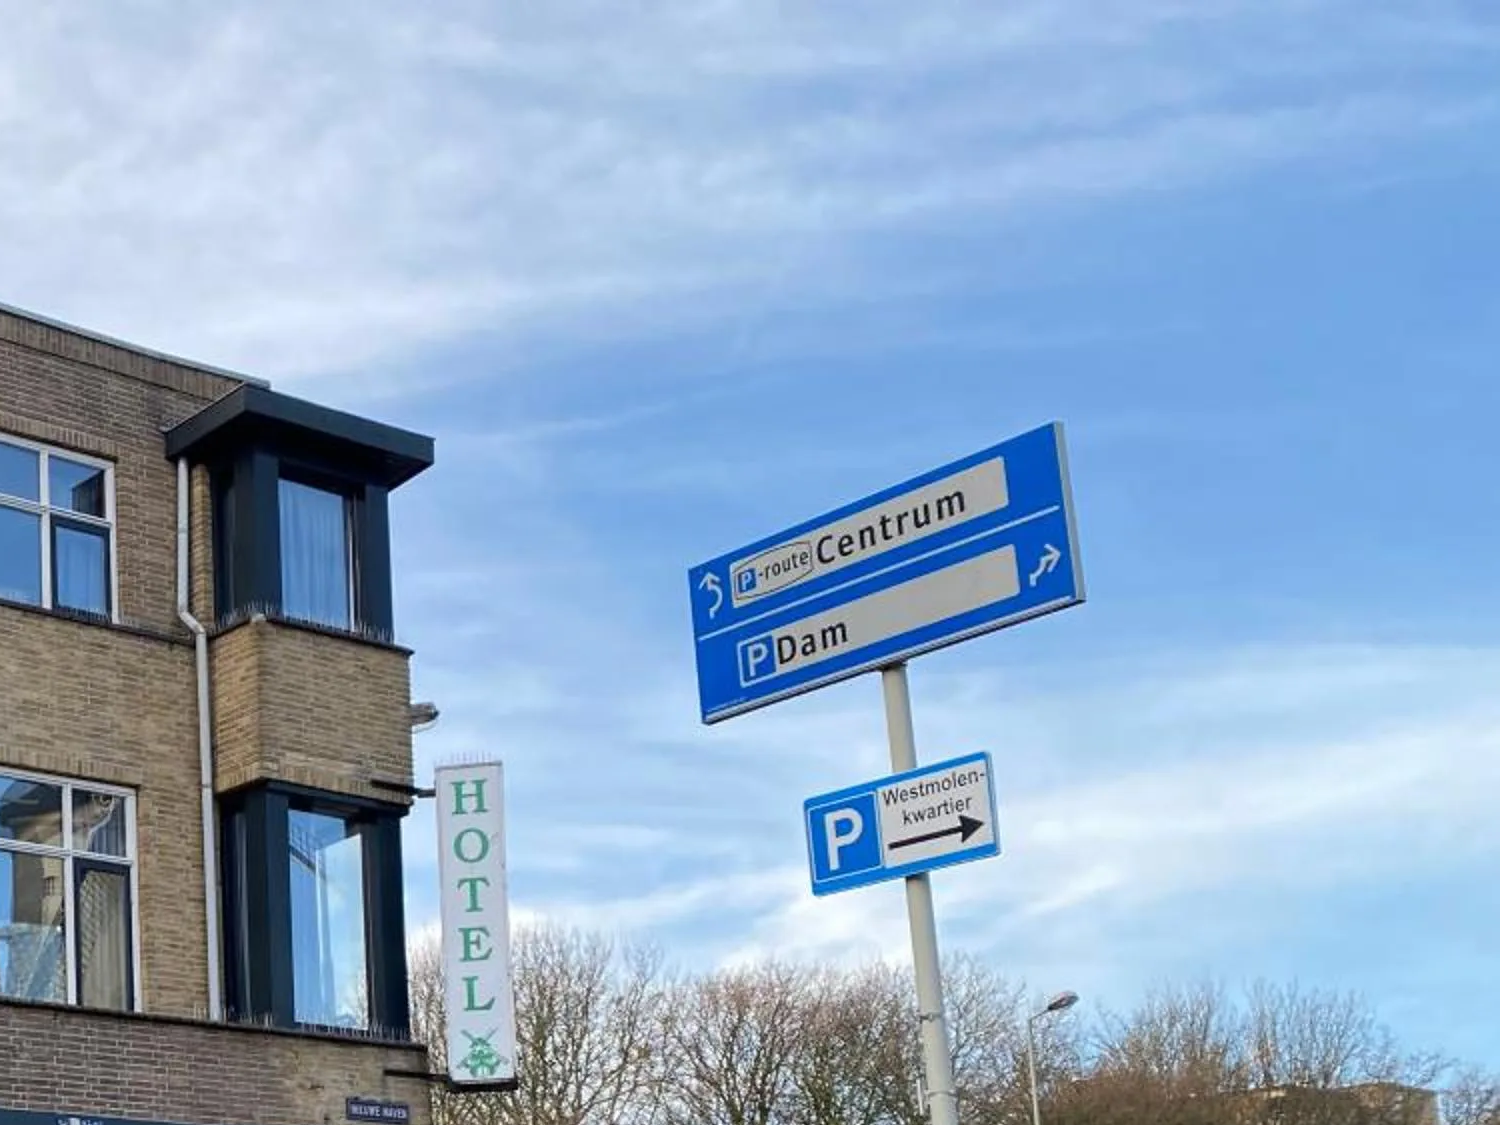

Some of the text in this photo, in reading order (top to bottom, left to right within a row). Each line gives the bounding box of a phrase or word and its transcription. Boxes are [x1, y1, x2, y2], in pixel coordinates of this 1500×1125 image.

[816, 489, 966, 564] Centrum
[749, 621, 848, 677] P Dam
[882, 769, 985, 807] Westmolen-
[901, 796, 972, 826] kwartier
[823, 806, 864, 872] P
[450, 778, 496, 1013] HOTEL
